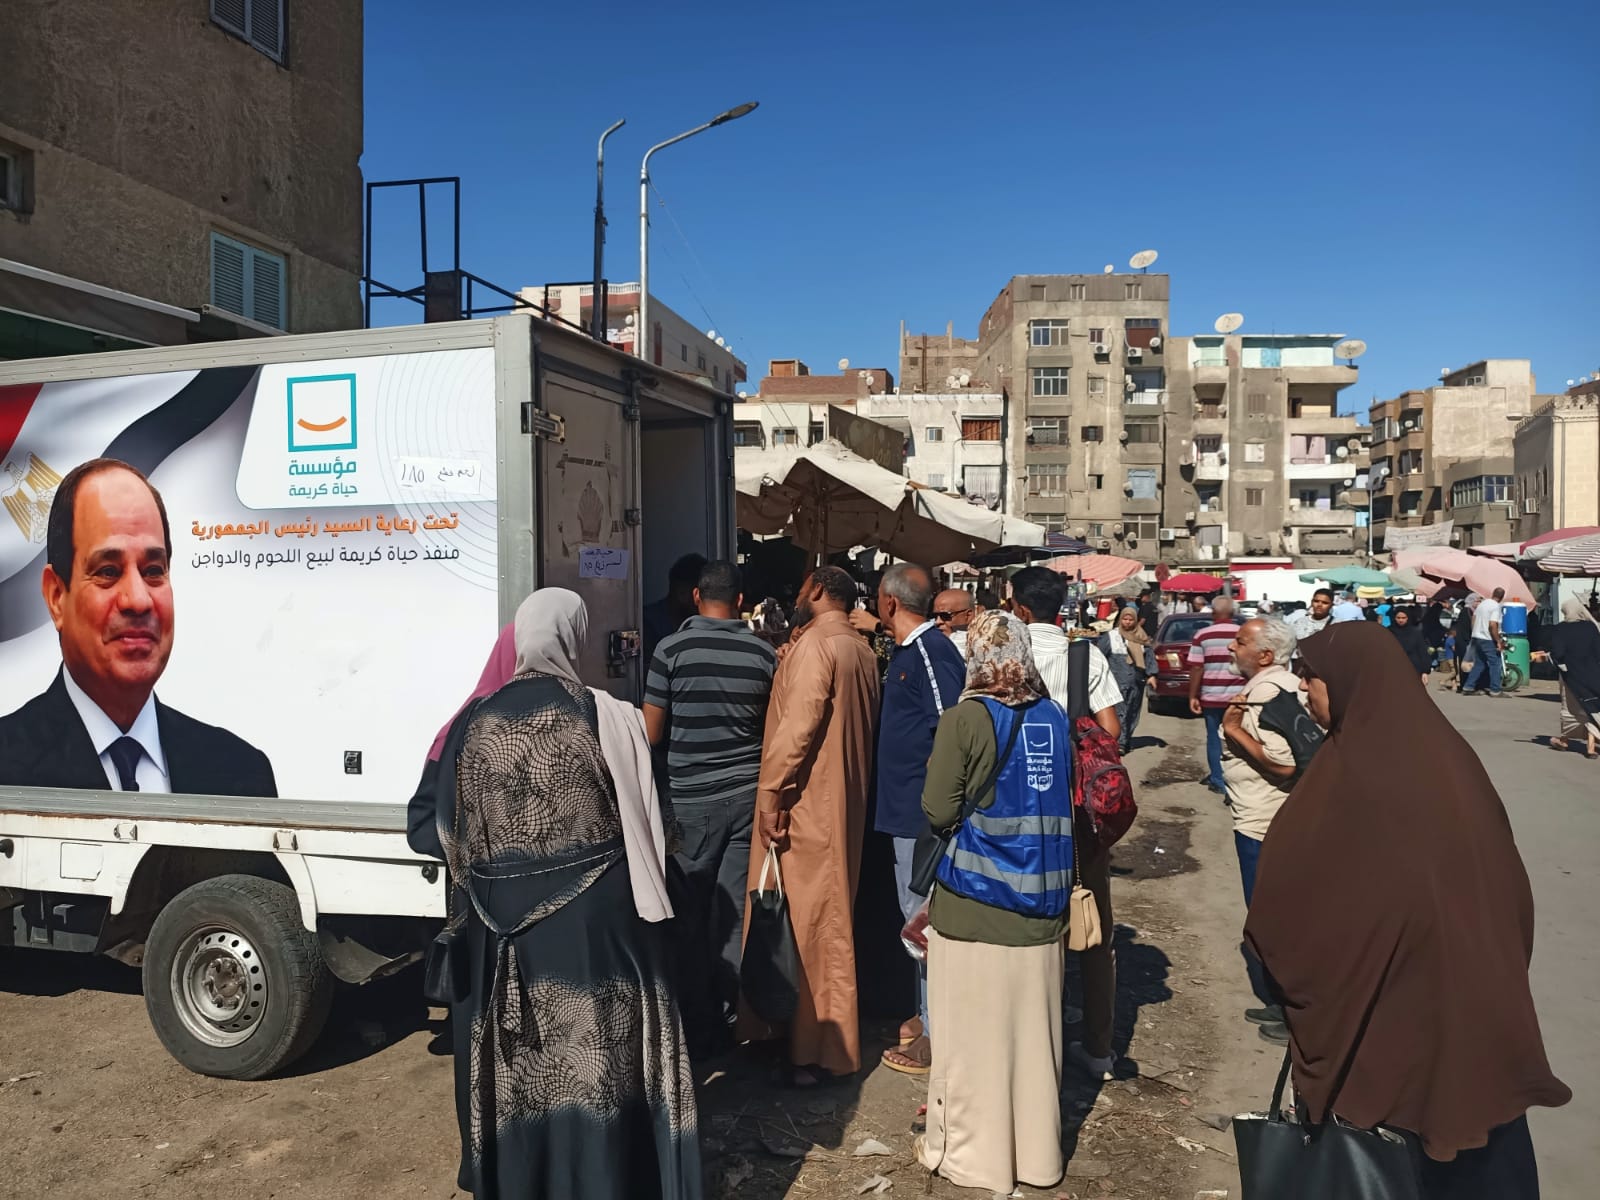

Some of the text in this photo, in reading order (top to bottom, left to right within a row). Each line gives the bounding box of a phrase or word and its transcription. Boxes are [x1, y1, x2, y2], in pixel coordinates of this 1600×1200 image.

[288, 457, 357, 479] مؤسسة
[288, 482, 358, 500] حياة كريمة
[191, 512, 459, 540] تحت رعاية السيد رئيس الجمهورية
[191, 545, 460, 570] منفذ حياة كريمة لبيع اللحوم والدواجن
